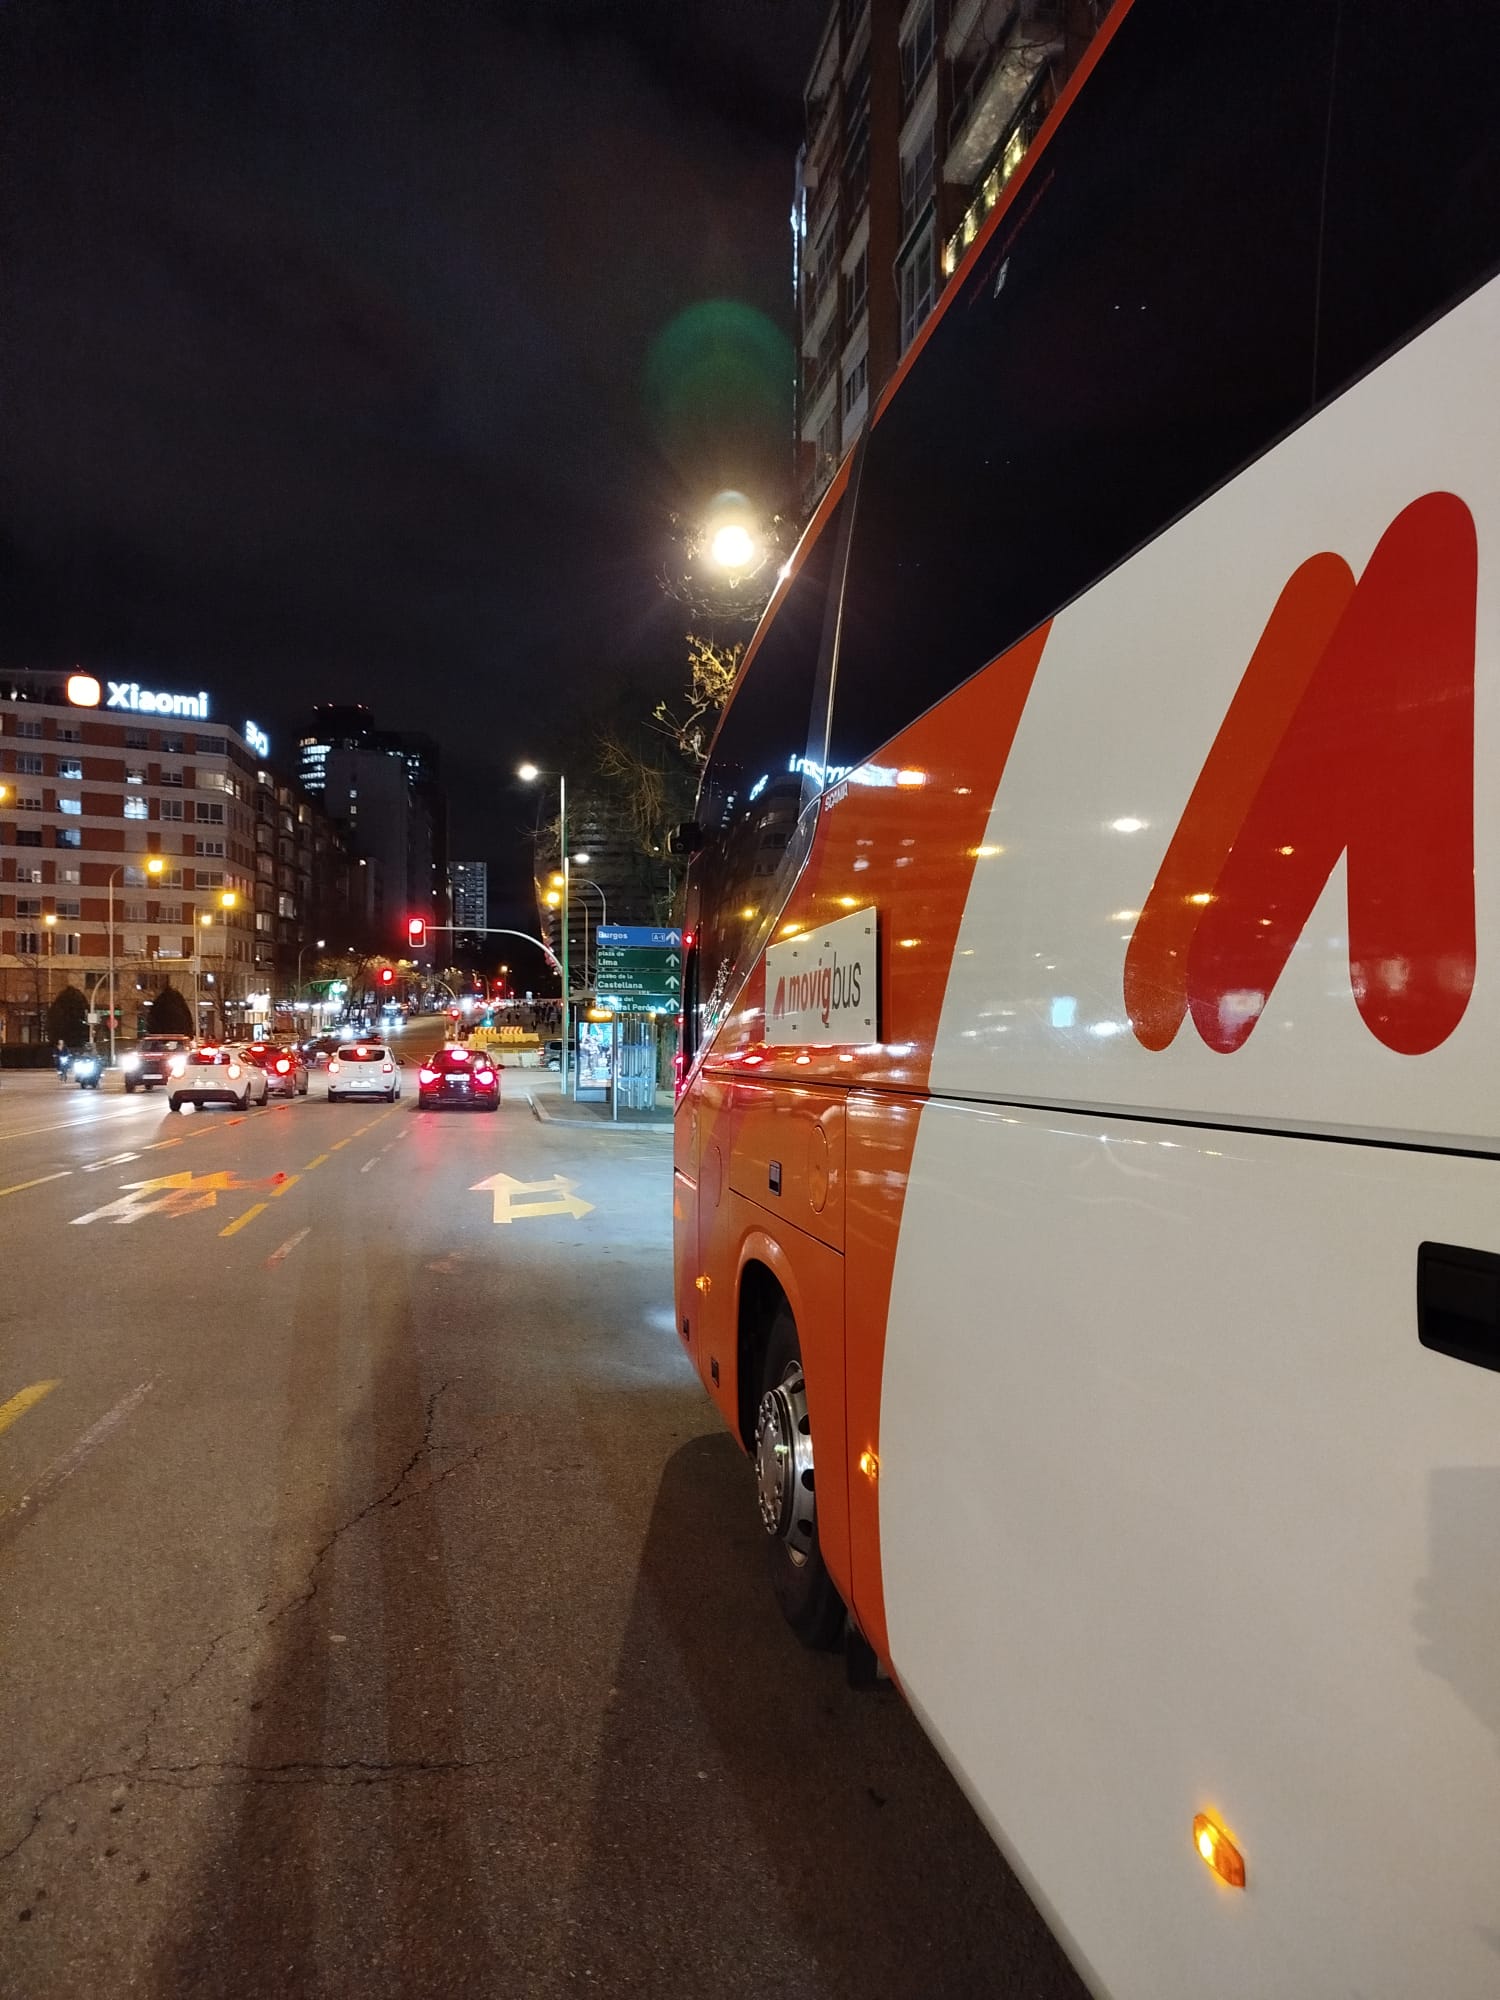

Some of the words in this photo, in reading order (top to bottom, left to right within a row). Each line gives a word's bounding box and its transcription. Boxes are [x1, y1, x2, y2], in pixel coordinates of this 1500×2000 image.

[106, 681, 208, 718] Xiaomi
[598, 930, 628, 940] Burgos
[598, 981, 643, 989] Castellana
[788, 951, 862, 1024] movigbus
